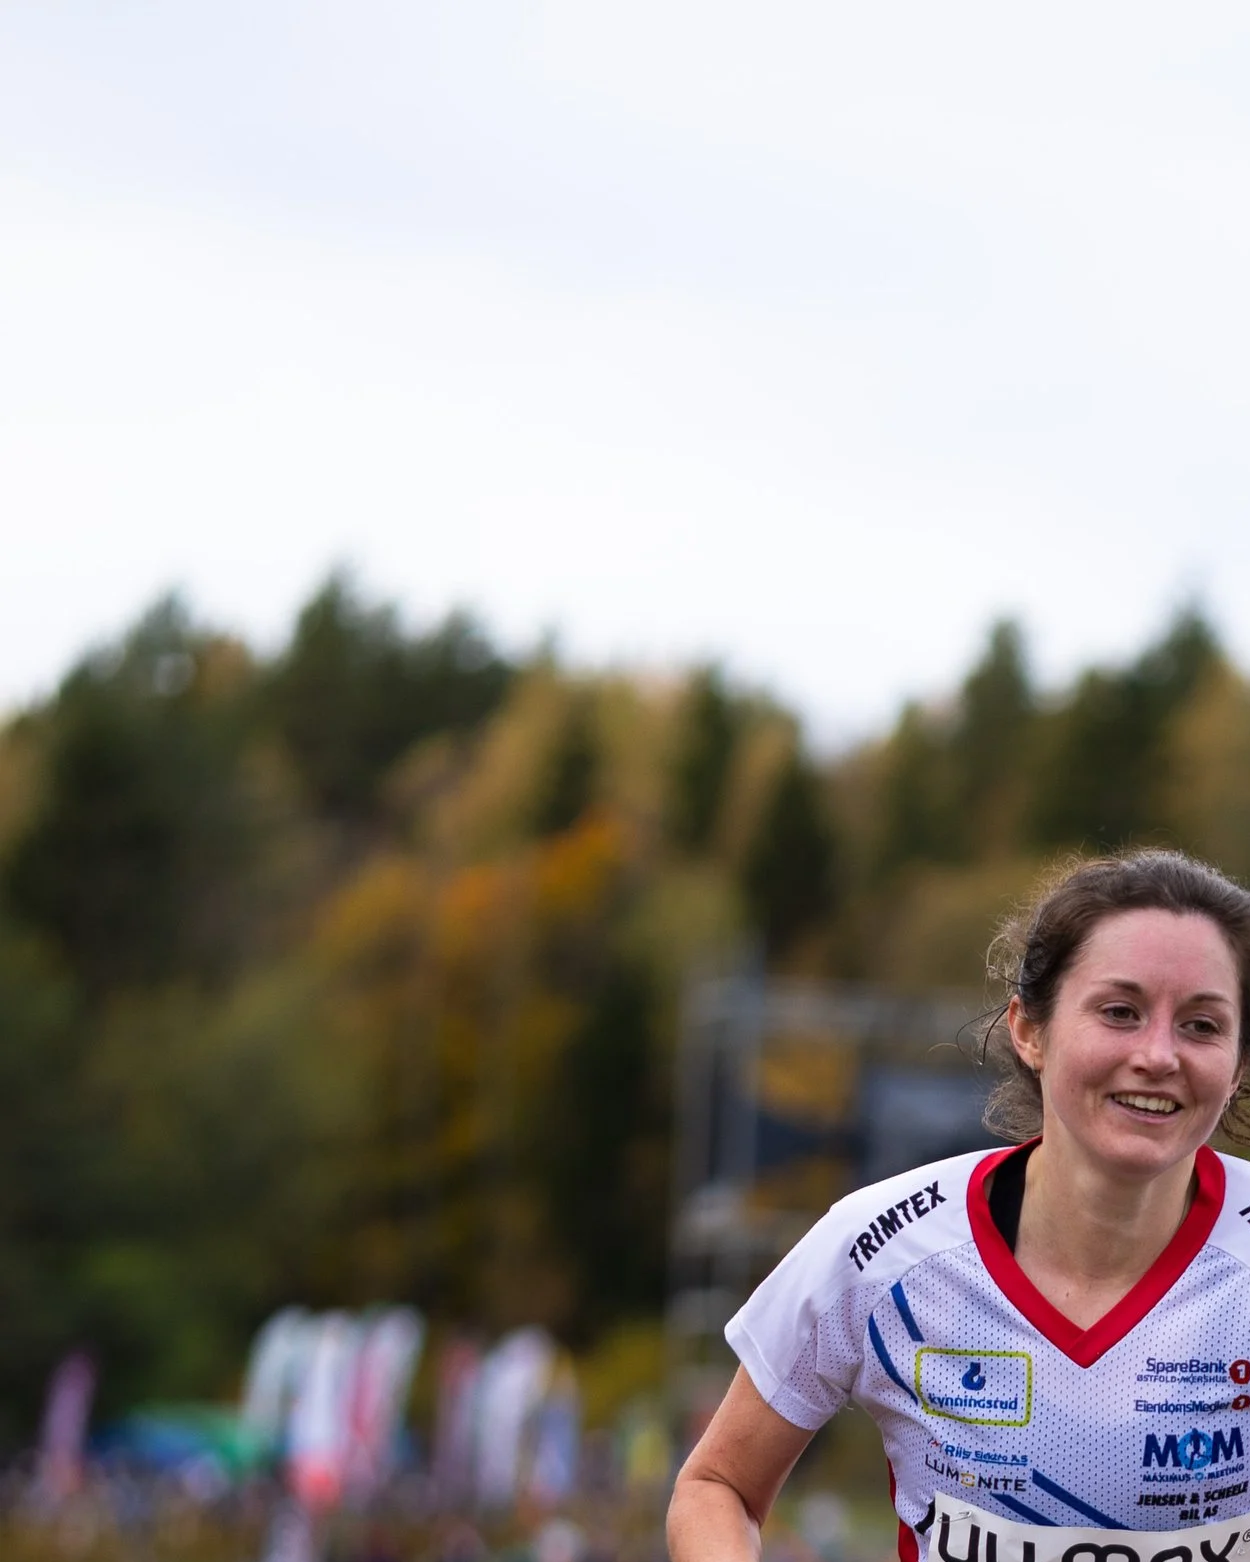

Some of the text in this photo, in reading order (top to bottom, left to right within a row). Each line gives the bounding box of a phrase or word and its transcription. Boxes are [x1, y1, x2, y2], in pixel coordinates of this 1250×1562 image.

[848, 1180, 947, 1272] TRIMTEX
[1146, 1357, 1228, 1375] SpareBank
[928, 1393, 1018, 1410] kynningsrud
[1135, 1399, 1231, 1415] EiendomsMegler
[925, 1454, 1027, 1492] LUMONITE
[1137, 1480, 1249, 1507] JENSEN & SCHEELE
[1180, 1505, 1219, 1521] BIL AS
